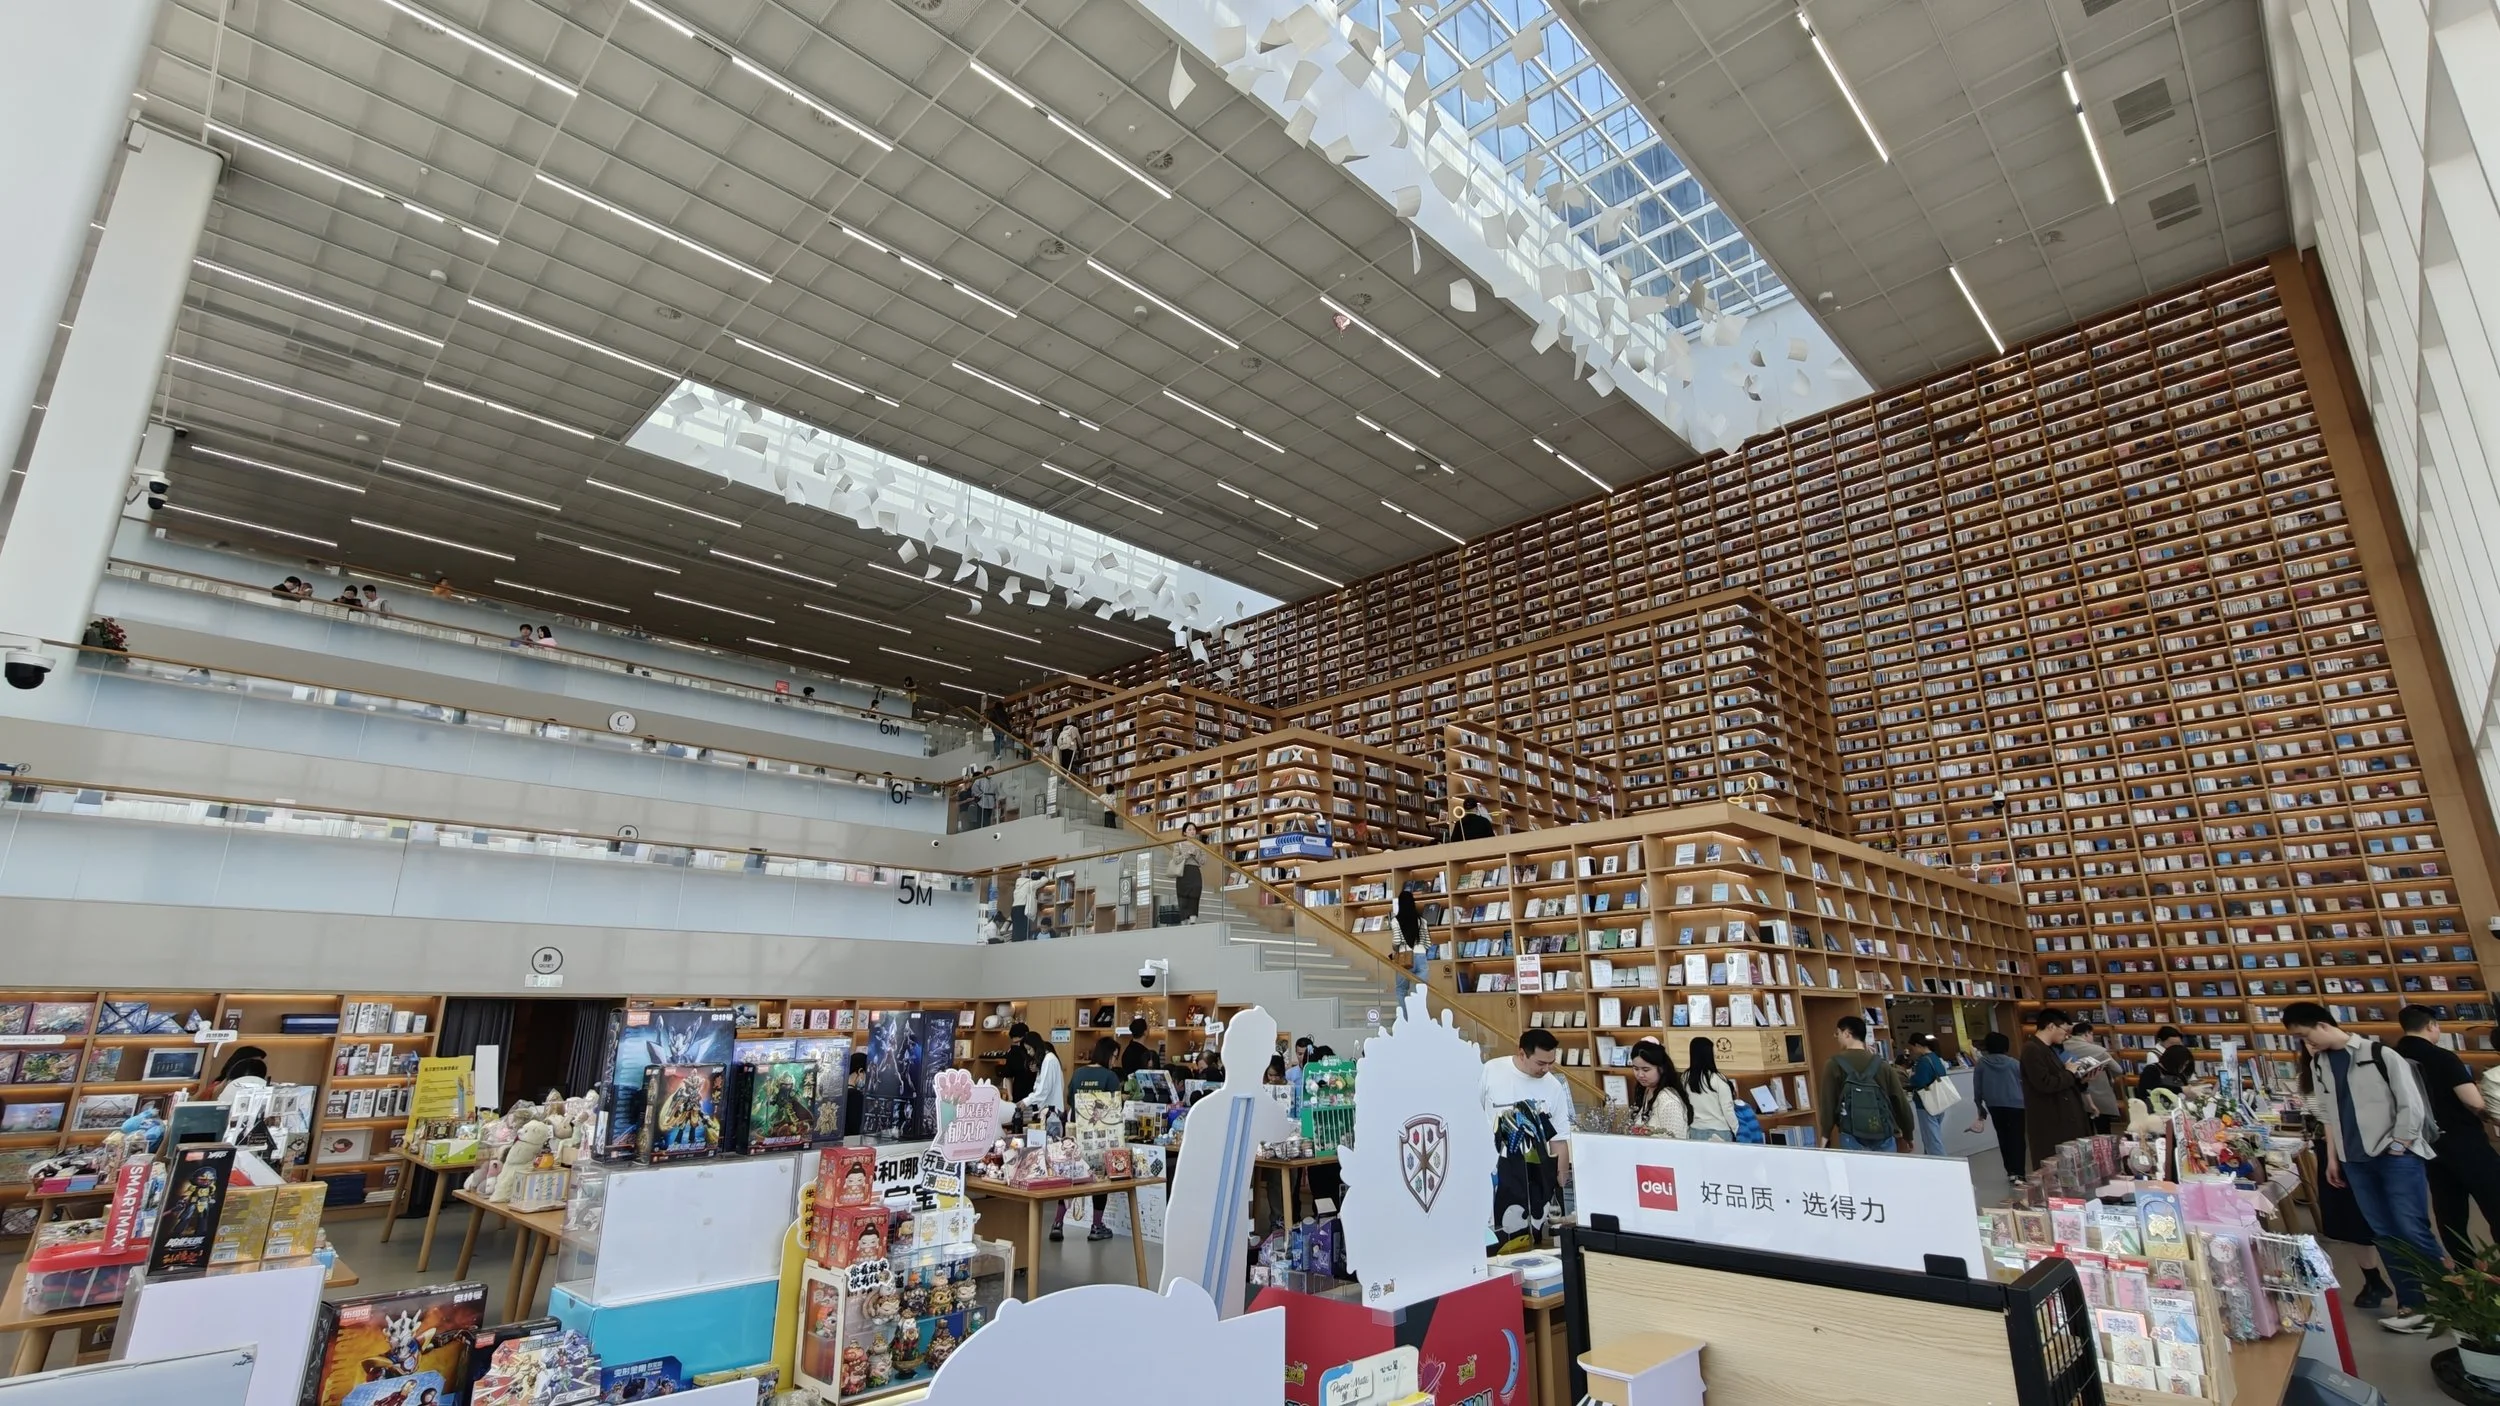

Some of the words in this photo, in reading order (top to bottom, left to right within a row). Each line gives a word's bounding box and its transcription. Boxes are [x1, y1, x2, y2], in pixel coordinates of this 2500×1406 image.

[873, 685, 888, 702] 7F
[879, 718, 900, 738] 6M
[891, 783, 913, 806] 6F
[898, 875, 933, 907] 5M
[948, 1121, 988, 1143] 郁见你
[1641, 1180, 1673, 1196] deli
[110, 1165, 144, 1249] SMARTMAX
[614, 1363, 647, 1378] 变形金刚
[1330, 1381, 1350, 1397] Paper
[1355, 1376, 1370, 1389] Mate
